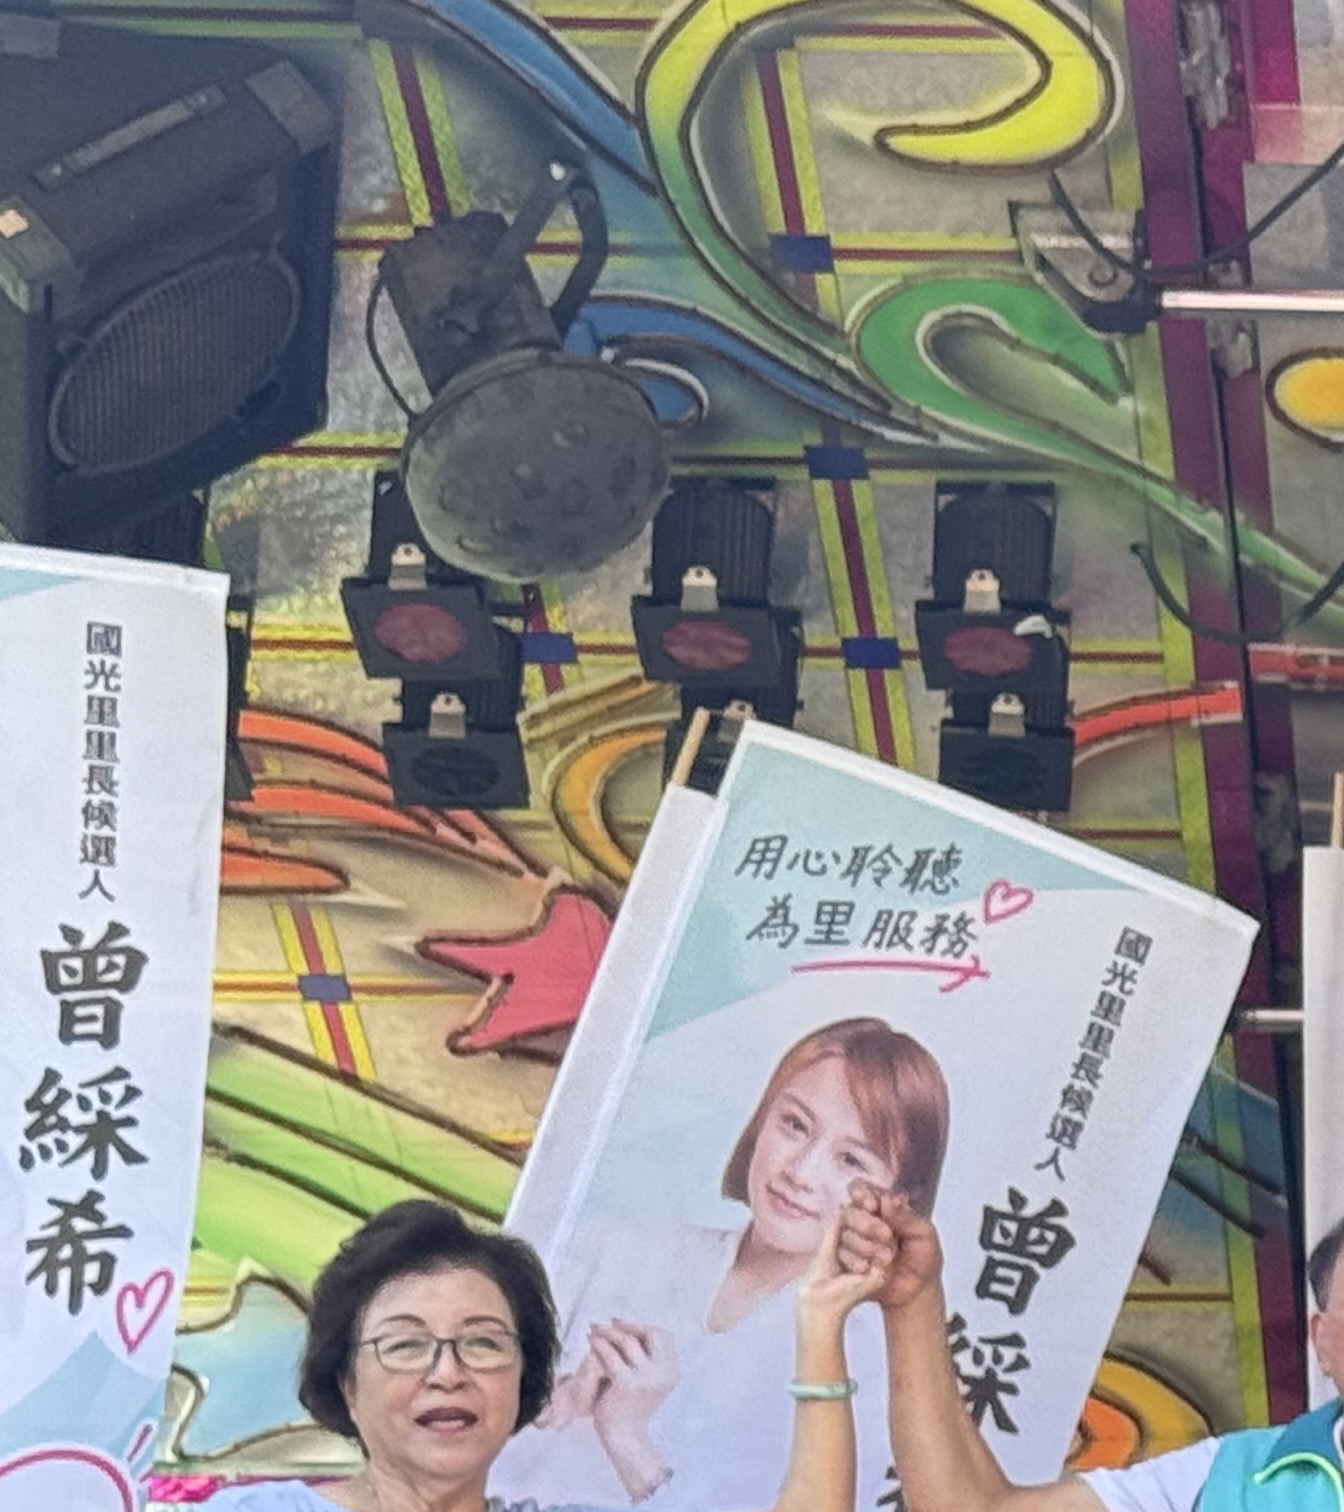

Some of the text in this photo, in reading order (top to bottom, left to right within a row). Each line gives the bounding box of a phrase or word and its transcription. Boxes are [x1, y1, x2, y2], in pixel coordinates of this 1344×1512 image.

[78, 621, 123, 902] 國光里里長候選人
[735, 834, 964, 896] 用心聆聽
[745, 894, 981, 960] 為里服務
[1034, 926, 1154, 1182] 國光里里長候選人
[19, 920, 149, 1316] 曾綵希
